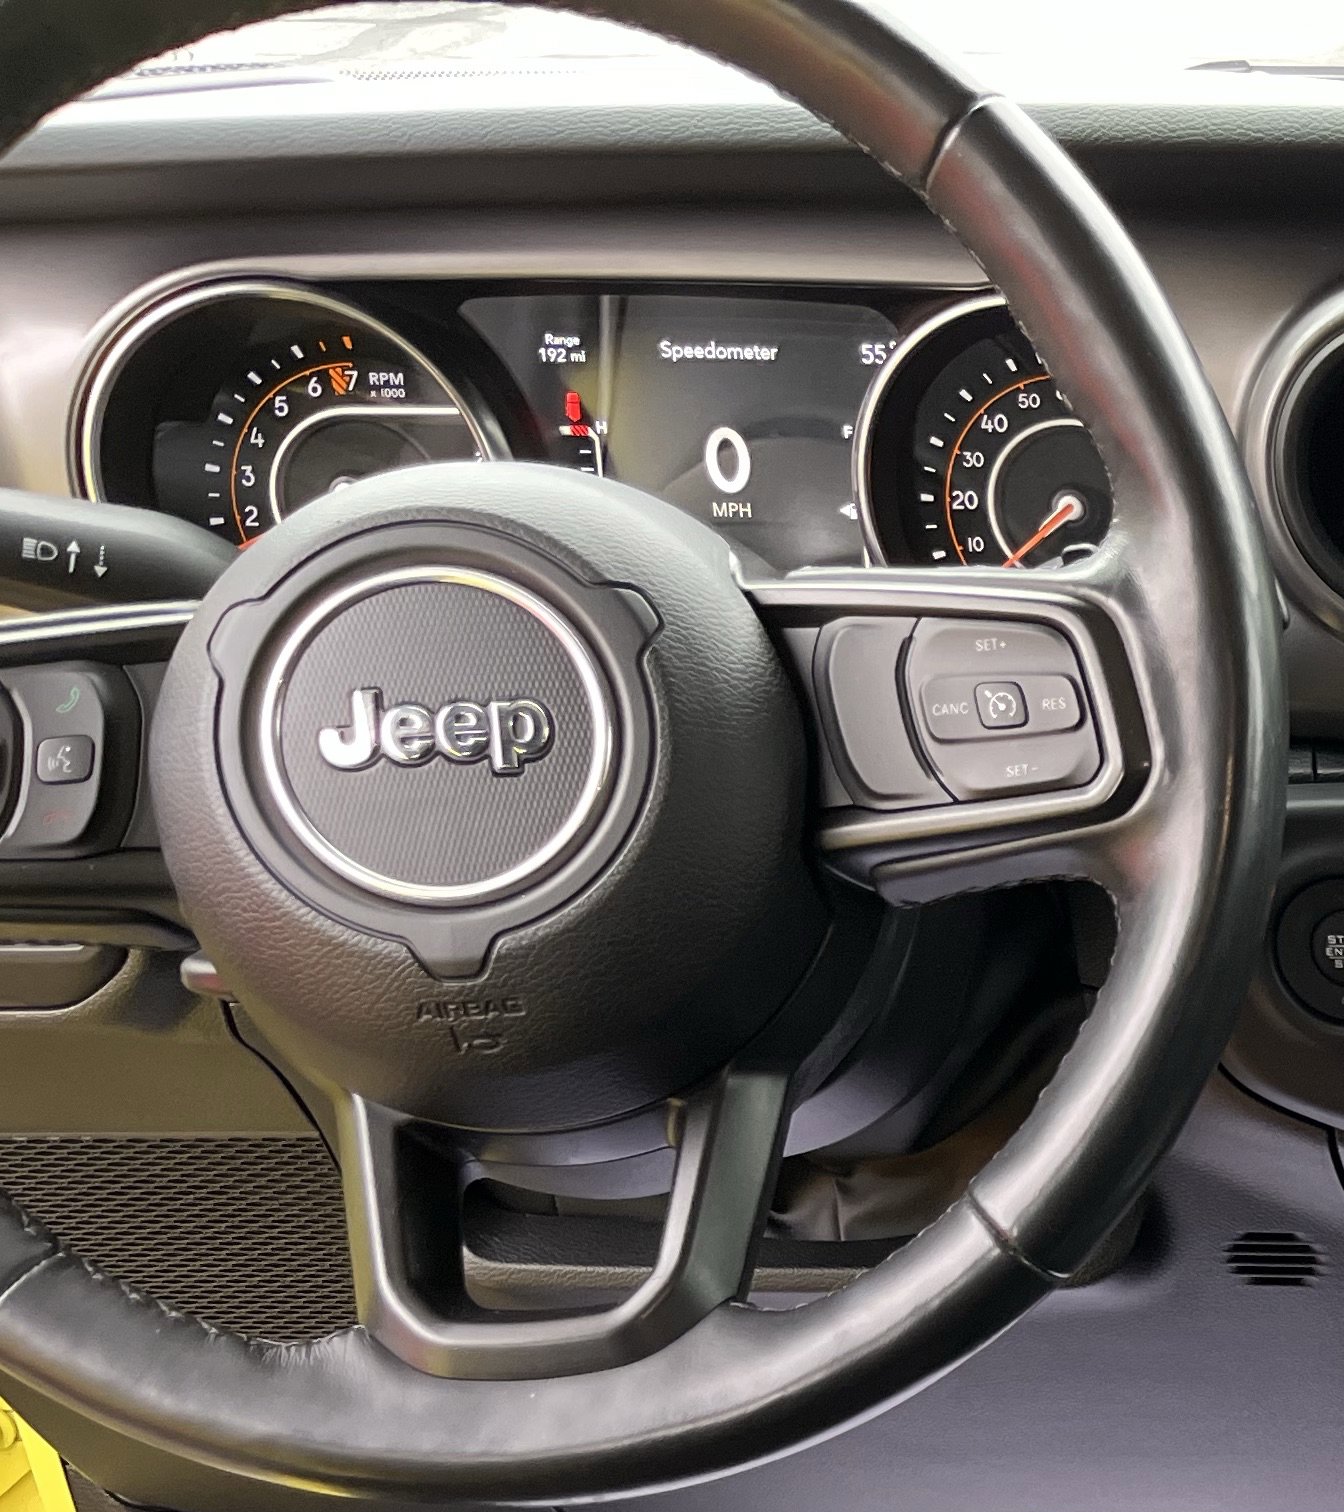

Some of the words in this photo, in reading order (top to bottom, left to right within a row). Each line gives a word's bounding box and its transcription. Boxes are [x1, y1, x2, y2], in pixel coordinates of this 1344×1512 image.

[544, 333, 581, 348] Range
[538, 347, 567, 363] 192
[570, 350, 586, 363] mi
[659, 340, 778, 362] Speedometer
[308, 377, 323, 397] 6
[344, 371, 358, 391] 7
[368, 372, 404, 386] RPM
[380, 388, 406, 398] 1000
[1018, 393, 1041, 409] 50
[274, 396, 289, 417] 5
[595, 421, 608, 434] H
[842, 425, 853, 438] F
[980, 414, 1009, 433] 40
[250, 427, 265, 448] 4
[705, 427, 751, 494] 0
[962, 452, 985, 468] 30
[240, 466, 255, 487] 3
[951, 491, 979, 510] 20
[244, 506, 260, 527] 2
[712, 502, 752, 519] MPH
[967, 537, 985, 552] 10
[932, 702, 969, 716] CANC
[1042, 697, 1067, 710] RES
[319, 686, 555, 778] Jeep
[416, 998, 526, 1021] AIRBAG
